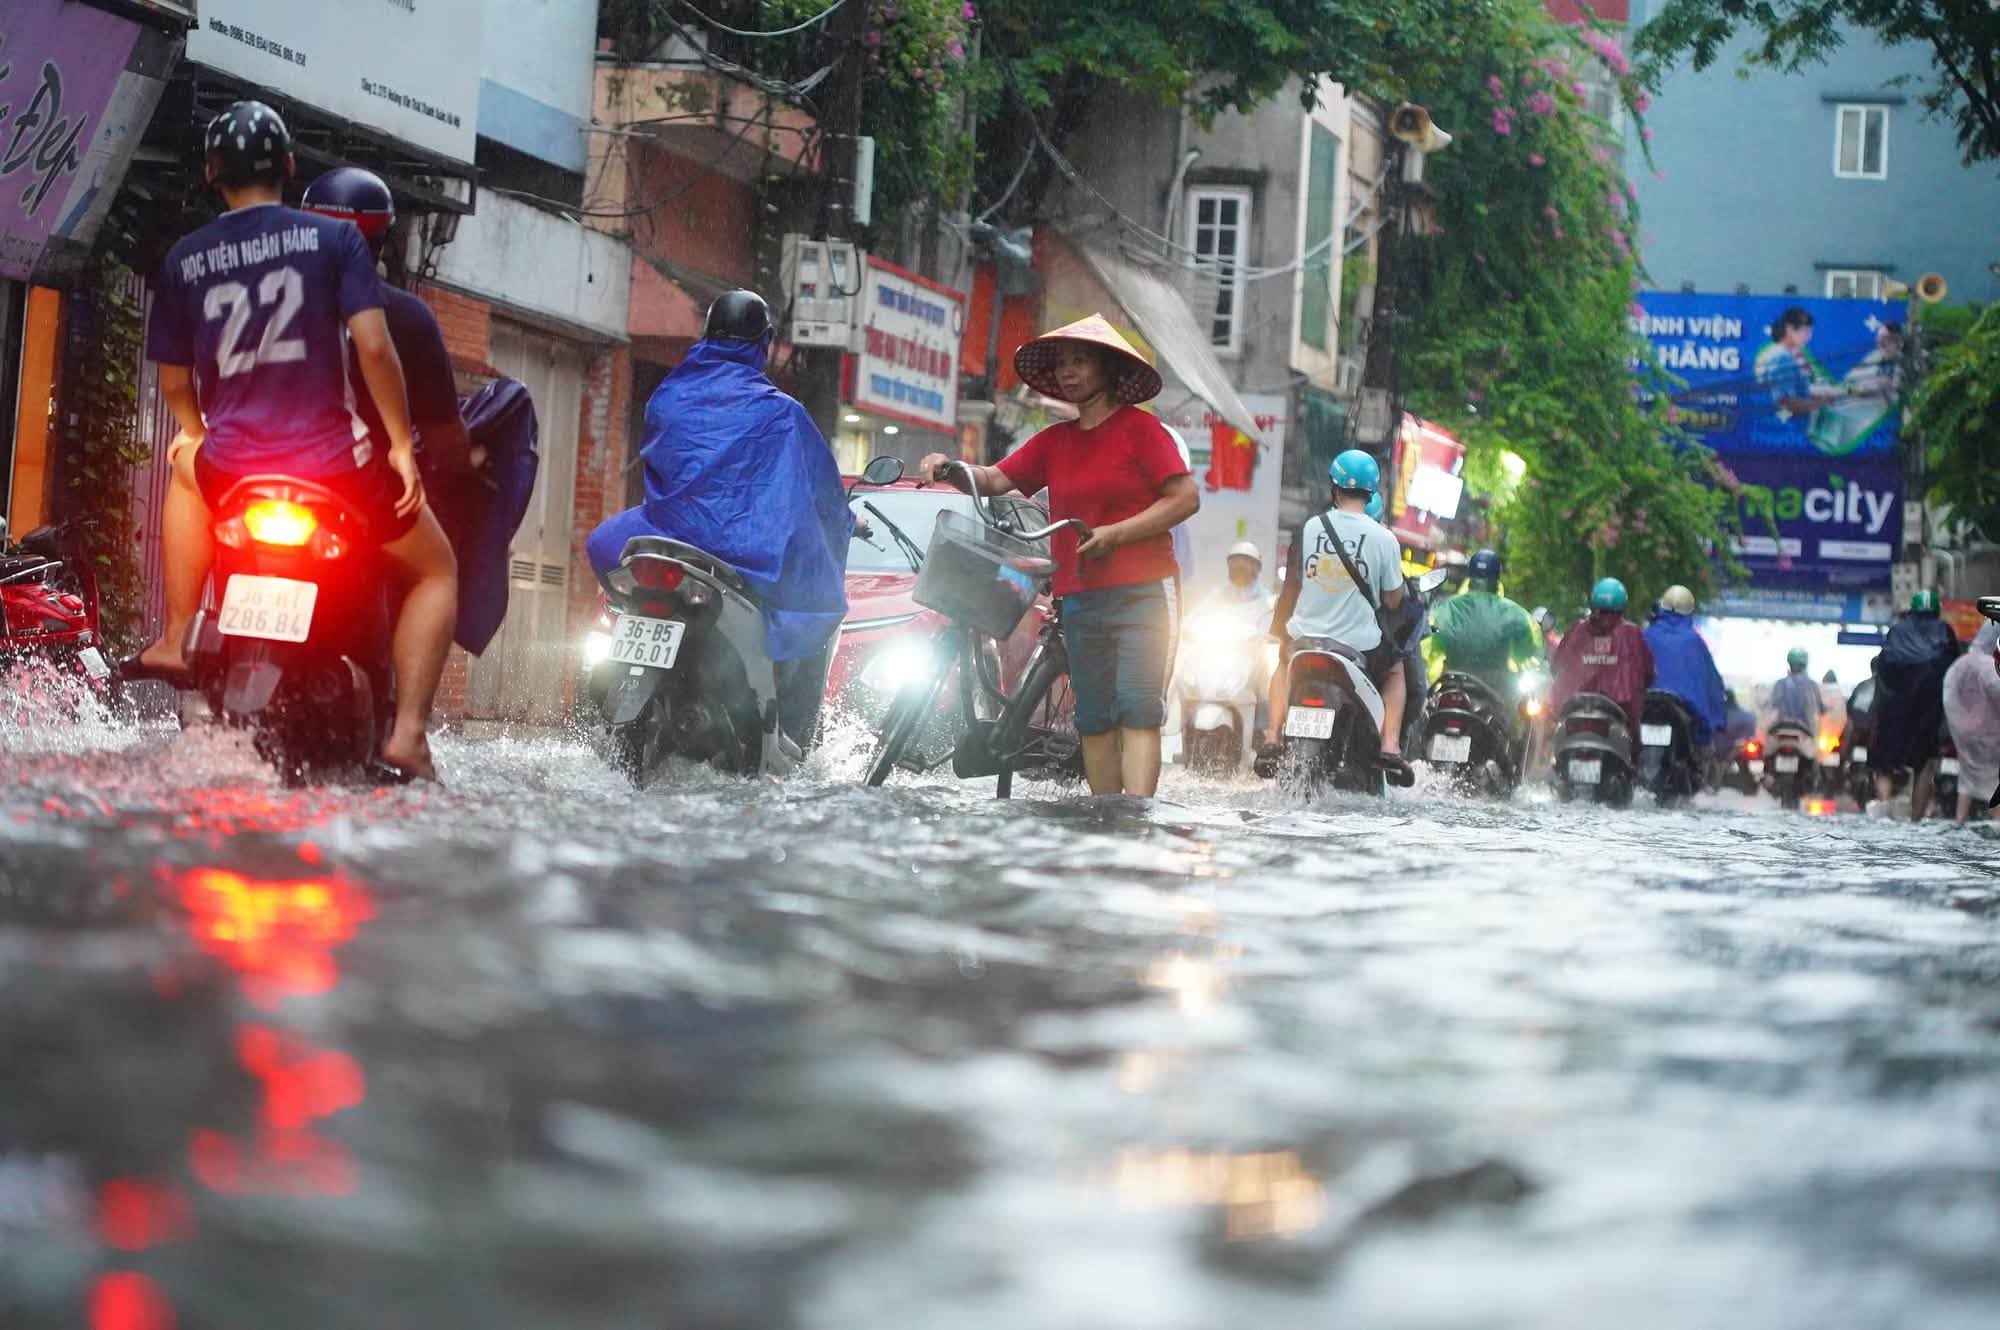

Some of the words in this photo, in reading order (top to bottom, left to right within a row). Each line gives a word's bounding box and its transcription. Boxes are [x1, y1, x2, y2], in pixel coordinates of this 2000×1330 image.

[181, 252, 206, 286] HỌC
[206, 240, 239, 276] VIỆN
[282, 223, 319, 255] HÀNG
[203, 264, 307, 380] 22
[1687, 313, 1742, 343] VIỆN
[624, 619, 674, 643] 36-B5
[613, 639, 672, 665] 076.01
